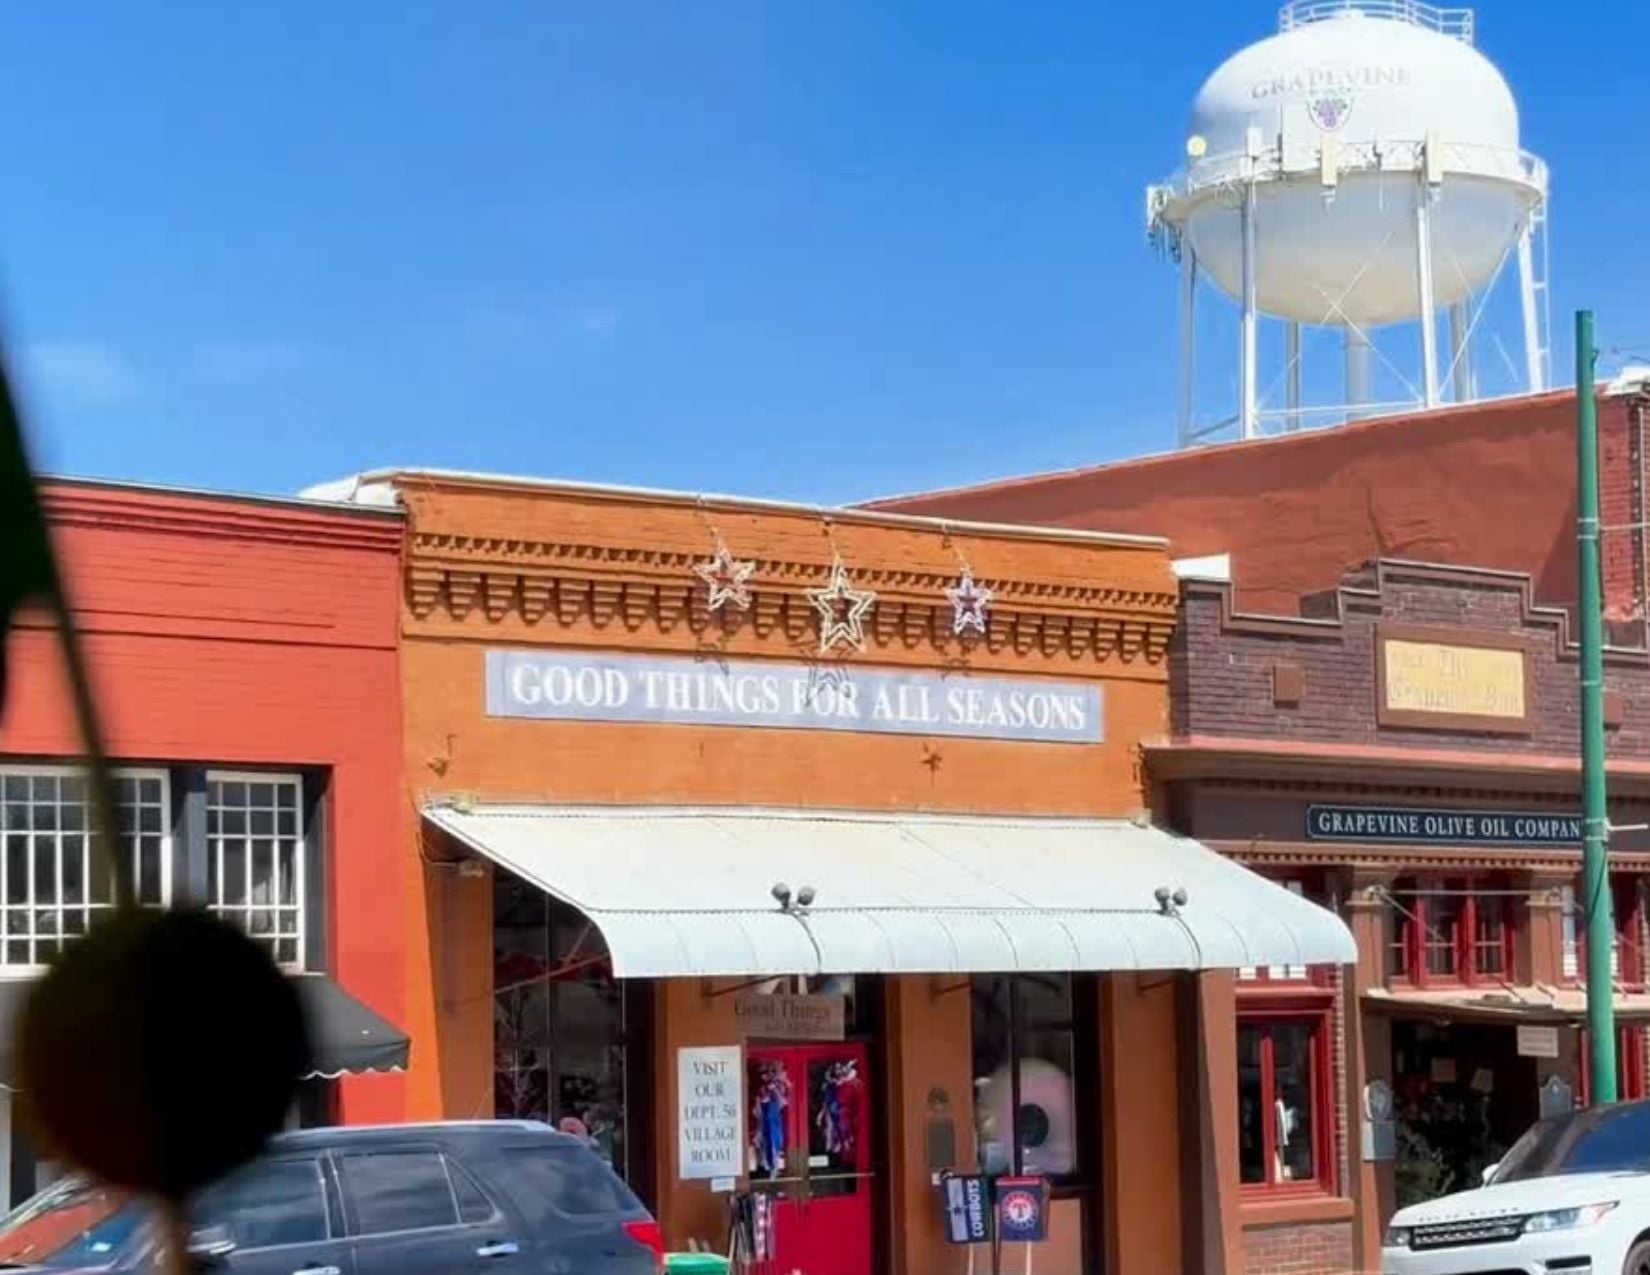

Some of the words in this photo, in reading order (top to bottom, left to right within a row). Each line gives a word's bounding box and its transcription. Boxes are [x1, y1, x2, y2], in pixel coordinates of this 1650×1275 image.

[1252, 66, 1410, 98] GRAPEVINE
[511, 664, 629, 708] GOOD
[637, 670, 780, 714] THINGS
[792, 678, 860, 719] FOR
[872, 683, 941, 723] ALL
[946, 686, 1087, 731] SEASONS
[1318, 812, 1419, 834] GRAPEVINE
[1424, 816, 1476, 836] OLIVE
[1480, 818, 1510, 837] OIL
[1514, 818, 1582, 838] COMPAN
[693, 1061, 728, 1075] VISIT
[695, 1082, 724, 1097] OUR
[684, 1126, 736, 1141] VILLAGE
[691, 1148, 731, 1162] ROOM
[966, 1179, 984, 1237] COWBOYS
